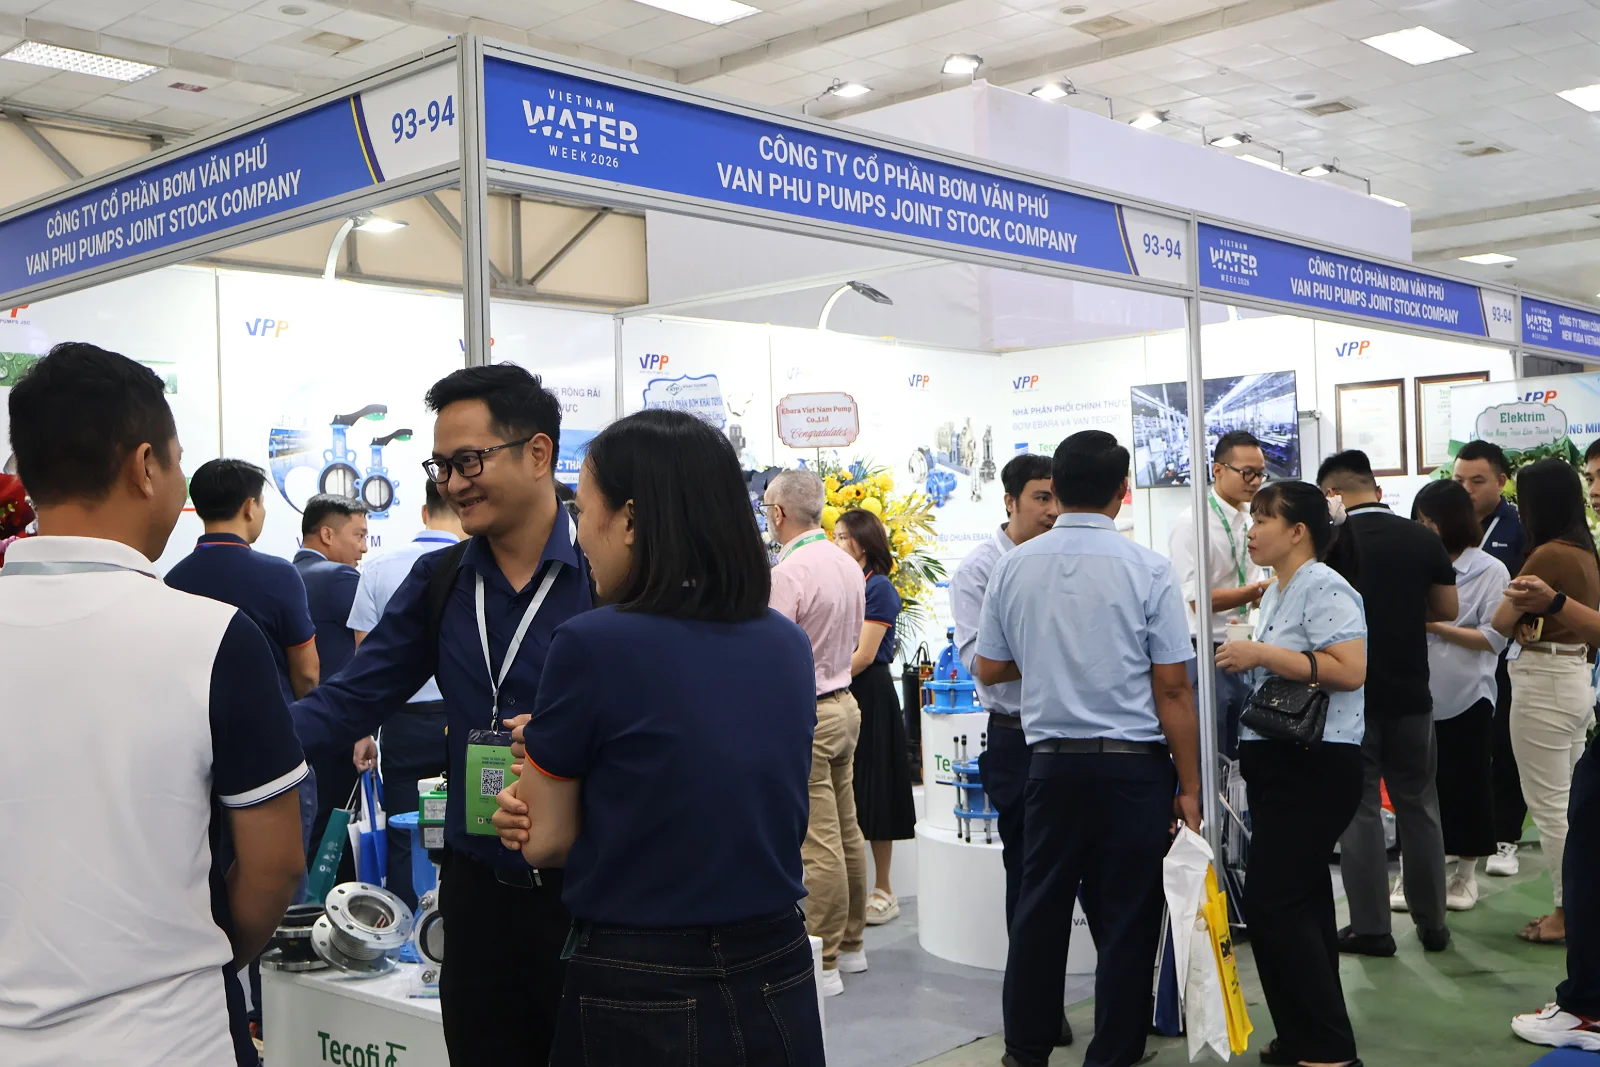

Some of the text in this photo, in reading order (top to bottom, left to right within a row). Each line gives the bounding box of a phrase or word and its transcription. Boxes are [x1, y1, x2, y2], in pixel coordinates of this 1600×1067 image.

[548, 88, 614, 112] VIETNAM
[392, 95, 454, 144] 93-94
[522, 100, 640, 154] WATER
[549, 144, 619, 168] WEEK 2026
[759, 134, 1048, 219] CÔNG TY CỔ PHẦN BƠM VĂN PHÚ
[47, 138, 267, 239] CÔNG TY CỔ PHẦN BƠM VĂN PHÚ
[717, 162, 1077, 254] VAN PHU PUMPS JOINT STOCK COMPANY
[26, 169, 301, 276] VAN PHU PUMPS JOINT STOCK COMPANY
[1143, 233, 1181, 260] 93-94
[1220, 239, 1248, 250] VIETNAM
[1210, 247, 1258, 276] WATER
[1220, 274, 1236, 284] WEEK
[1308, 256, 1335, 278] CÔNG
[1336, 264, 1348, 281] TY
[1350, 264, 1363, 284] CỔ
[1365, 268, 1389, 290] PHẦN
[1428, 283, 1444, 301] PHÚ
[1290, 277, 1458, 324] VAN PHU PUMPS JOINT STOCK COMPANY
[1492, 306, 1512, 324] 93-94
[1526, 313, 1552, 333] WATER
[246, 318, 288, 338] VPP
[1336, 340, 1370, 357] VPP
[639, 354, 669, 370] VPP
[908, 374, 929, 388] VPP
[1013, 375, 1039, 390] VPP
[1031, 406, 1052, 414] PHÂN
[1500, 412, 1545, 423] Elektrim
[790, 427, 848, 441] Congratulates
[1033, 419, 1058, 429] EBARA
[318, 1031, 379, 1067] Tecofi
